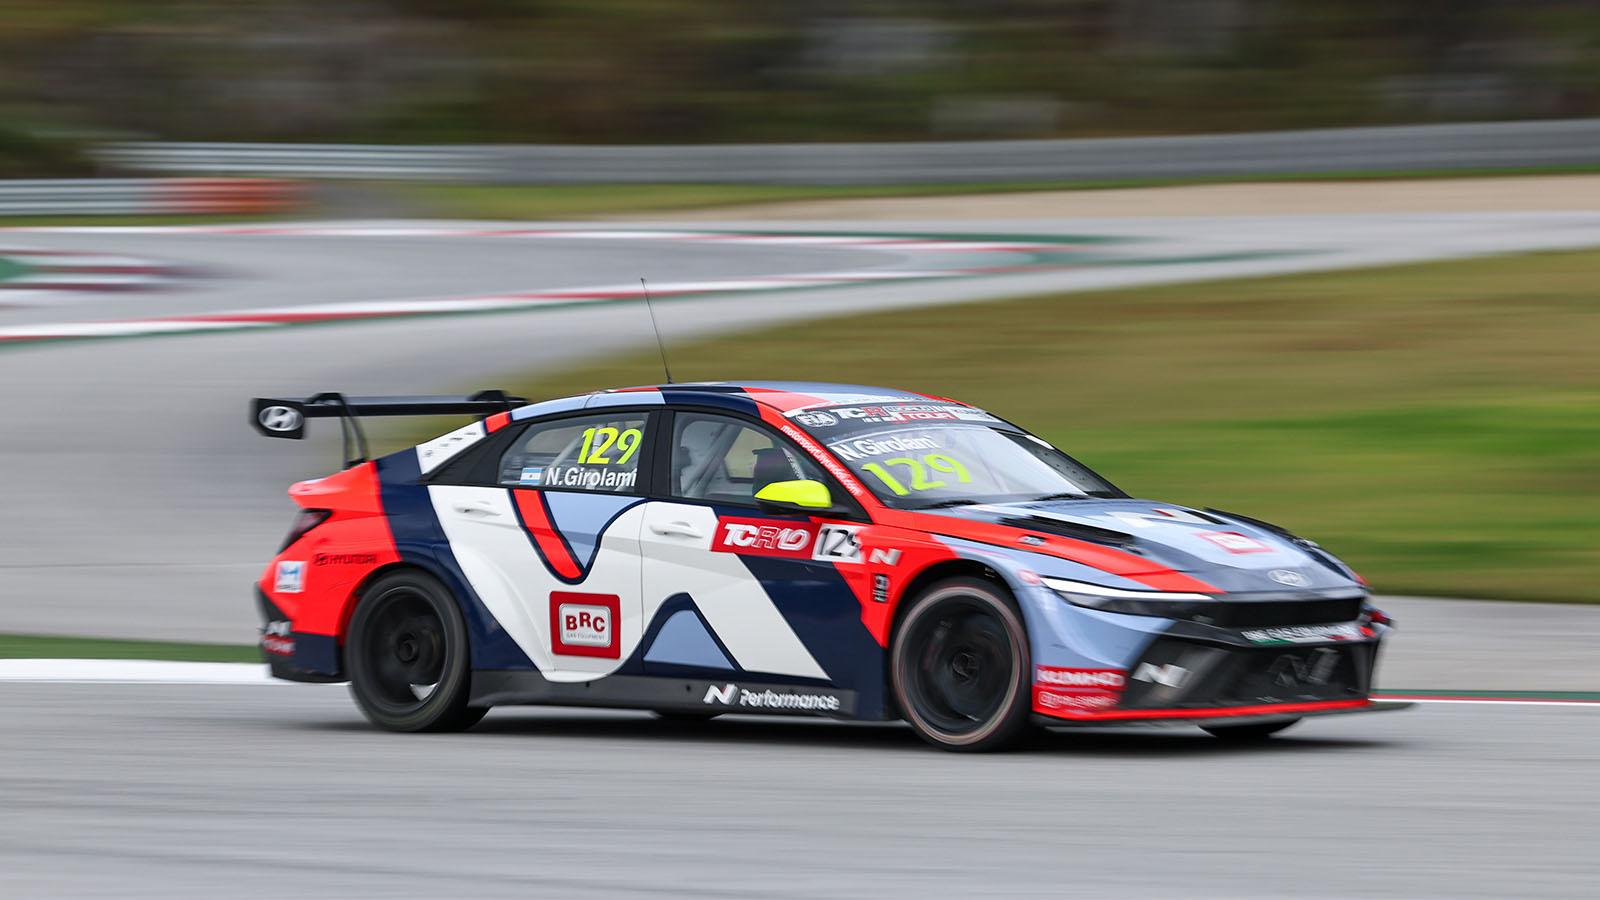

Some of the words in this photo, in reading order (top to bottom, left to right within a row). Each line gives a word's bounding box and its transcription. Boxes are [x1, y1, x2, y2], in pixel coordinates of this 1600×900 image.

[577, 427, 642, 465] 129
[545, 467, 637, 487] N.Girolami
[861, 454, 971, 496] 129
[566, 611, 606, 633] BRC
[740, 689, 840, 710] Performance
